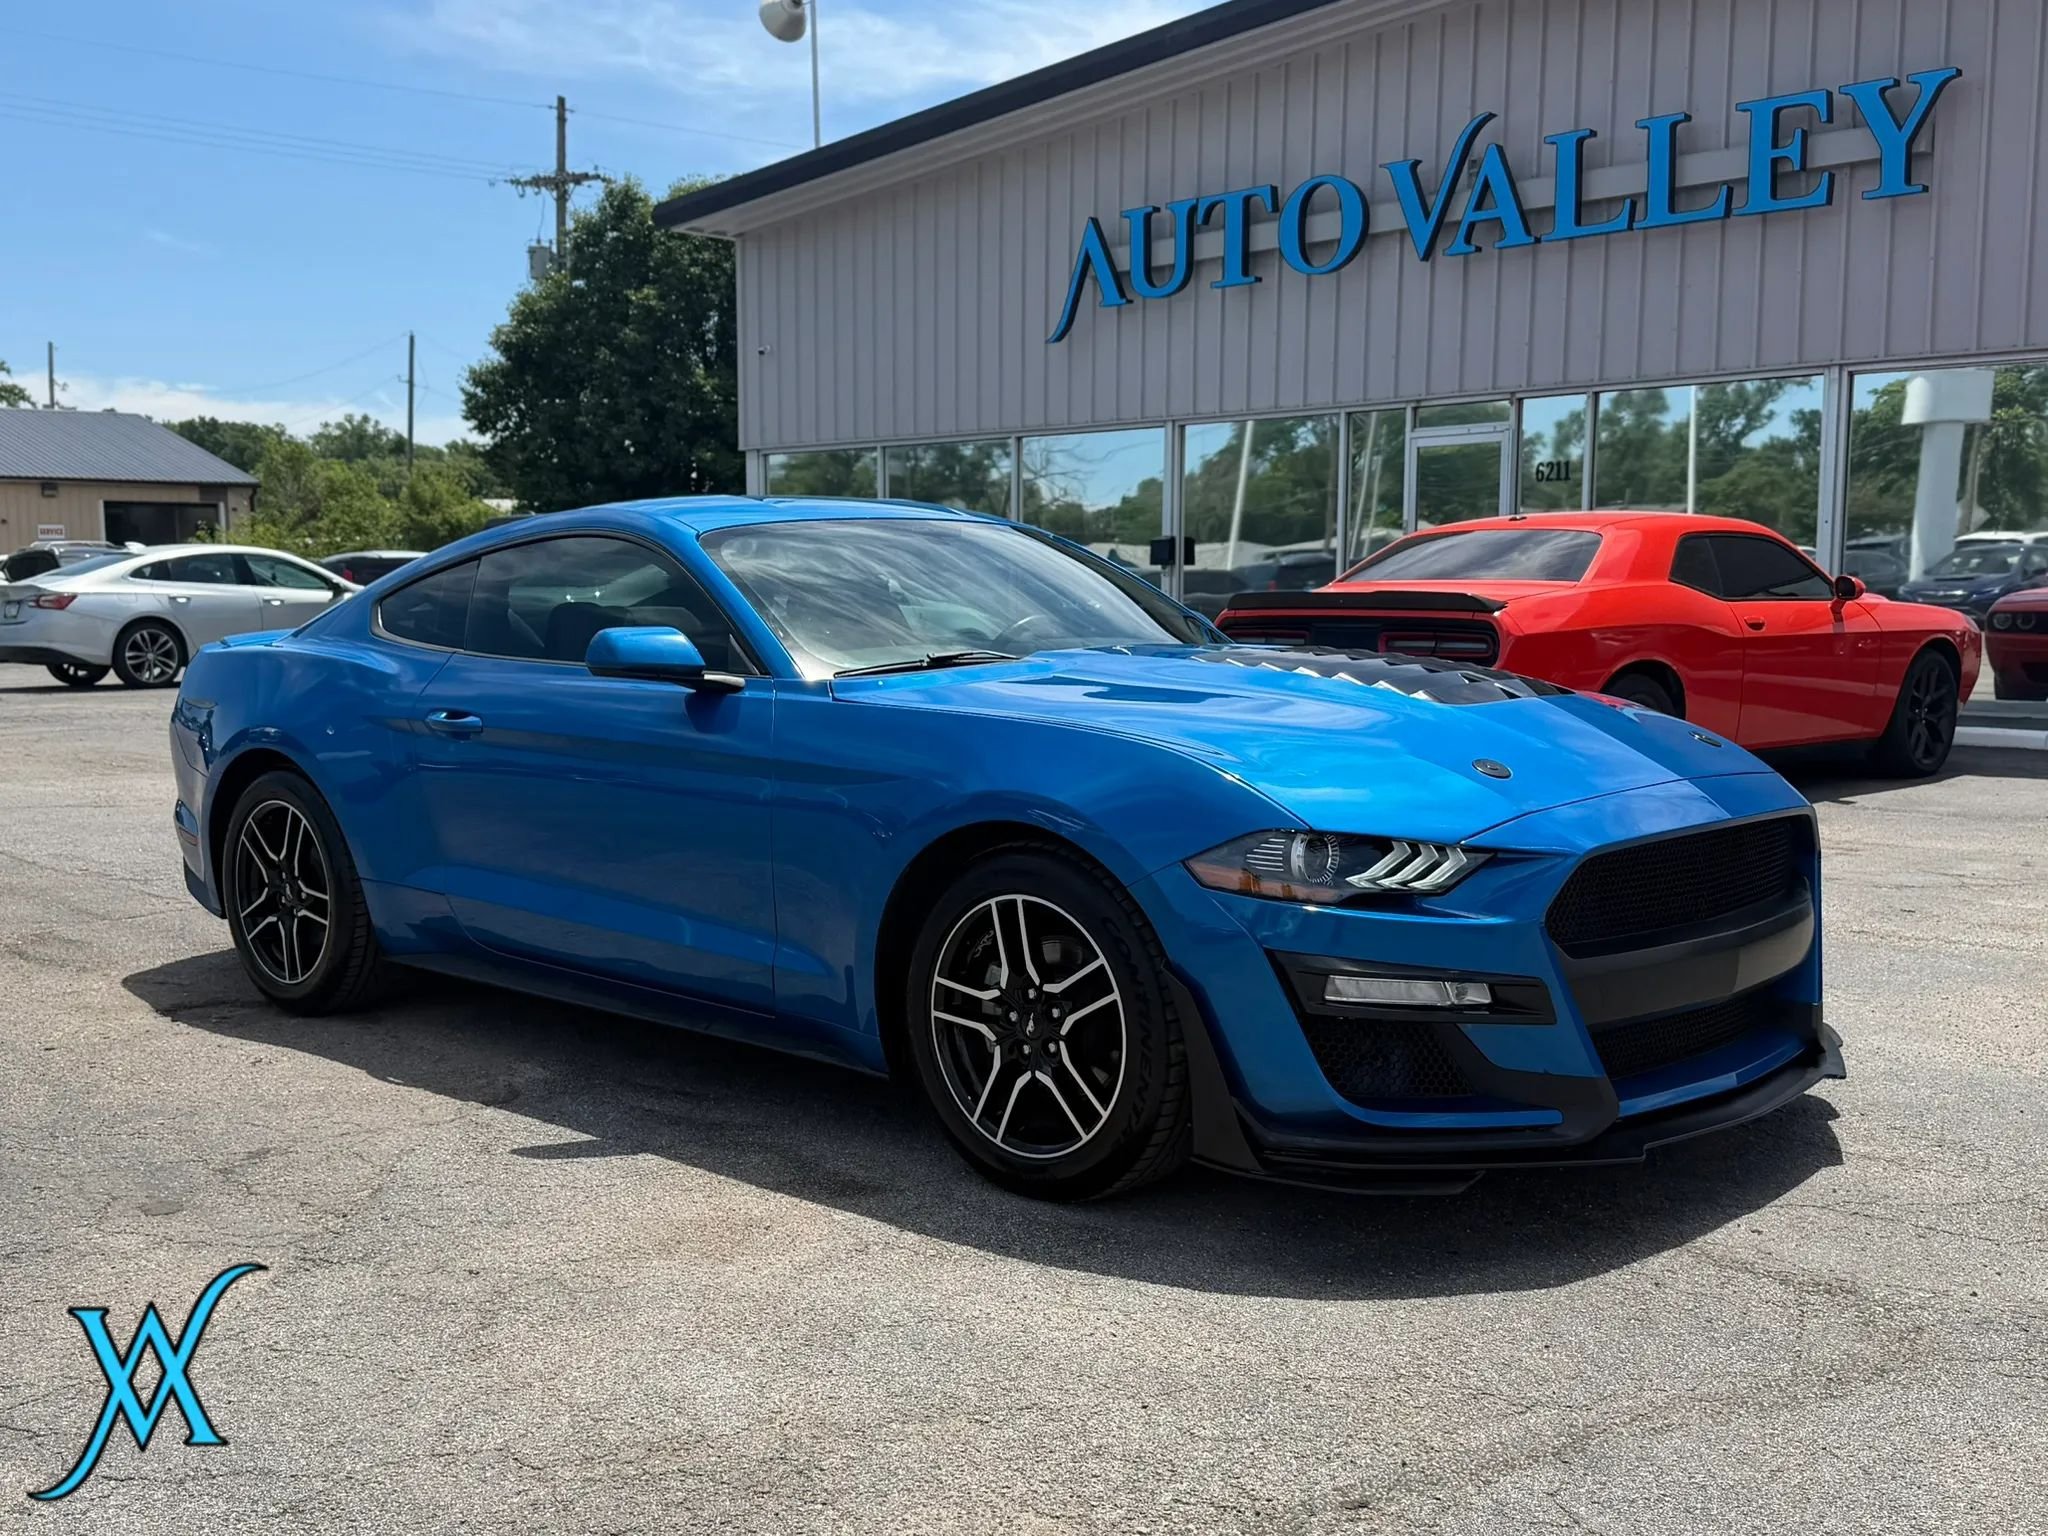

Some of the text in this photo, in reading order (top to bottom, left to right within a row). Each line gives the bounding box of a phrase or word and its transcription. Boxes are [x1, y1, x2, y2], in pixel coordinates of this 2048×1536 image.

[1047, 66, 1963, 345] AUTO VALLEY
[1535, 461, 1571, 482] 6211
